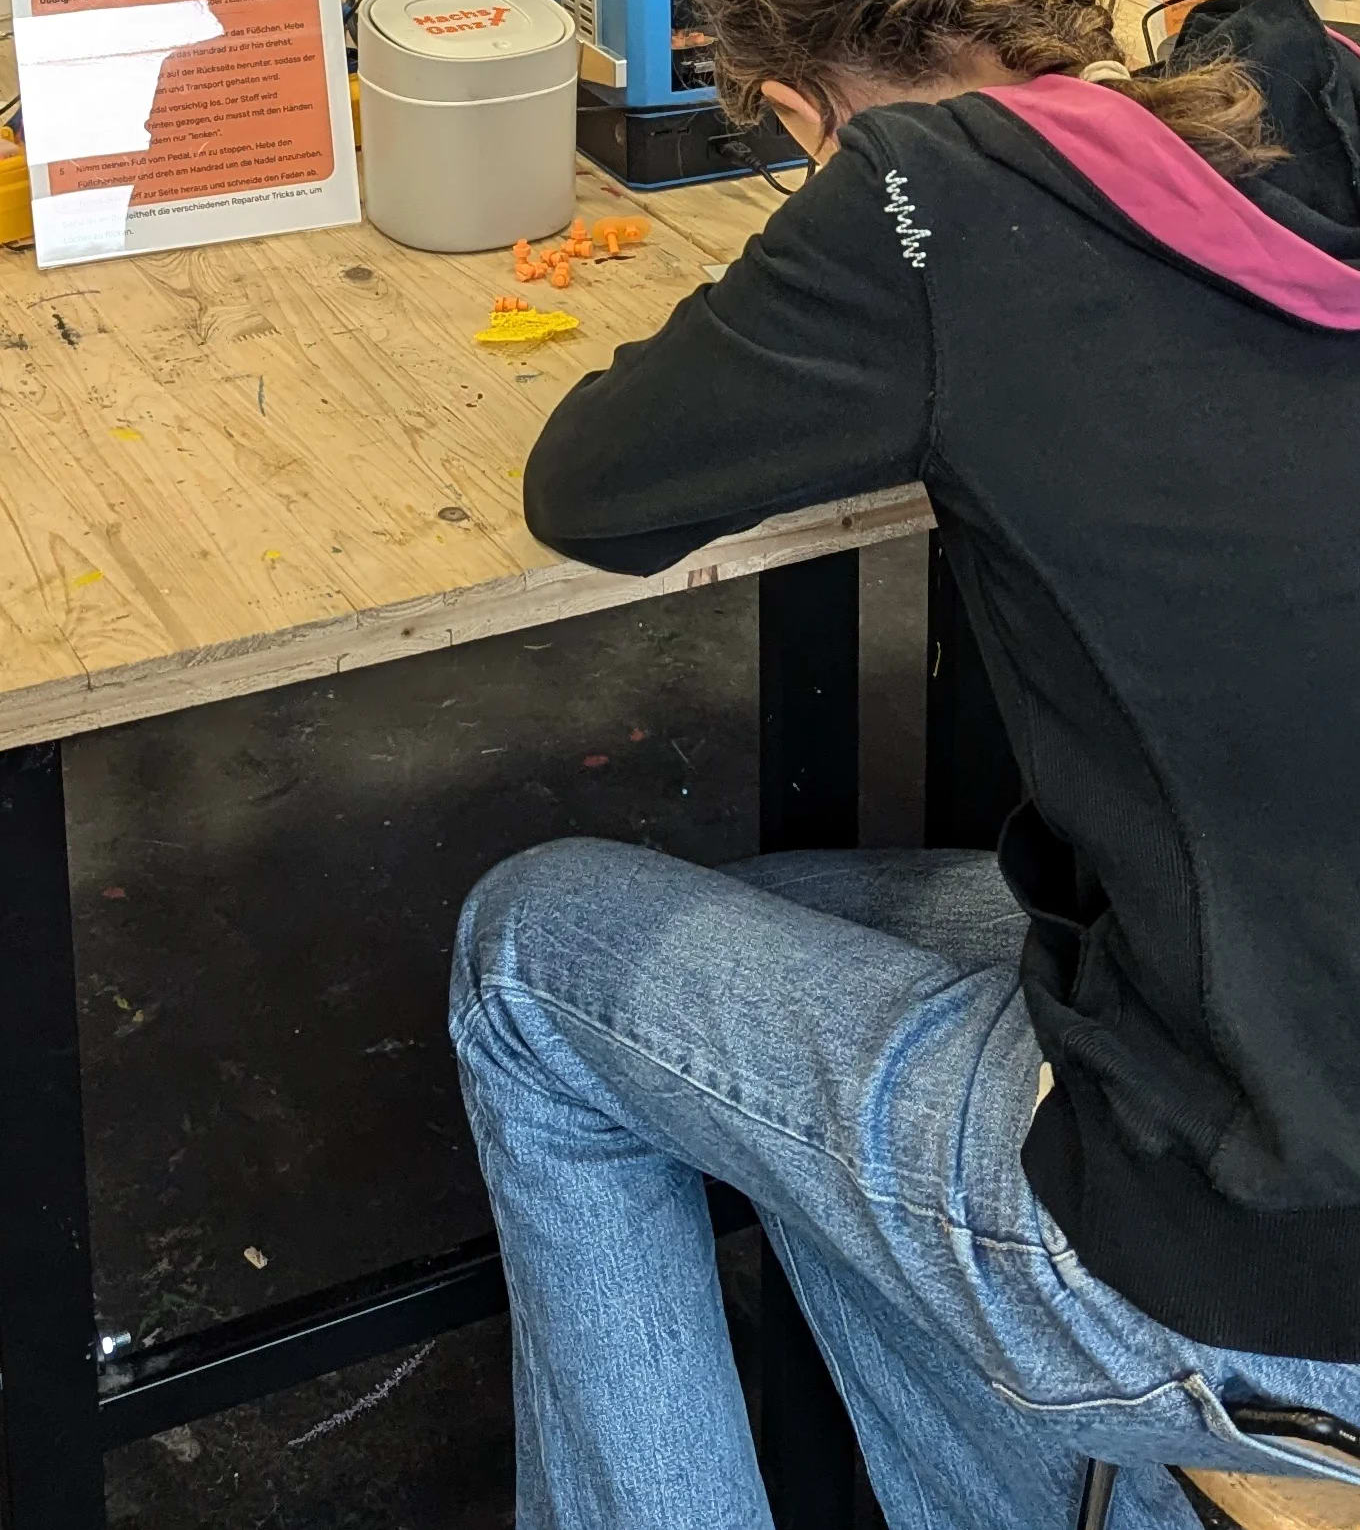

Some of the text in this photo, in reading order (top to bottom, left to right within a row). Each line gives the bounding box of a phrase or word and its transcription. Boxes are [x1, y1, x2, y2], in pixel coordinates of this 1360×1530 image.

[413, 9, 491, 26] Machs
[231, 28, 244, 38] das
[284, 20, 304, 30] Hebe
[426, 21, 486, 35] Ganz
[192, 45, 226, 58] Handrad
[228, 44, 238, 53] zu
[252, 40, 264, 49] hin
[181, 66, 195, 76] der
[302, 53, 316, 62] der
[170, 82, 184, 93] und
[186, 79, 224, 94] Transport
[169, 100, 208, 114] vorsichtig
[225, 96, 238, 106] Der
[240, 93, 260, 103] Stoff
[260, 91, 278, 100] wird
[213, 113, 224, 122] du
[225, 110, 251, 120] musst
[252, 108, 265, 116] mit
[266, 106, 282, 115] den
[173, 134, 186, 142] nur
[131, 158, 147, 168] Fuß
[148, 154, 166, 164] vom
[208, 148, 218, 156] zu
[256, 140, 276, 150] Hebe
[278, 138, 293, 147] den
[138, 171, 154, 181] und
[155, 169, 174, 179] dreh
[176, 168, 189, 176] am
[190, 162, 224, 174] Handrad
[226, 160, 238, 169] um
[240, 158, 252, 168] die
[254, 154, 277, 166] Nadel
[144, 189, 157, 198] zur
[158, 186, 179, 197] Seite
[180, 182, 208, 193] heraus
[210, 180, 225, 190] und
[227, 176, 262, 188] schneide
[264, 174, 279, 183] den
[281, 170, 304, 181] Faden
[158, 186, 322, 216] die verschiedenen Reparatur Tricks um
